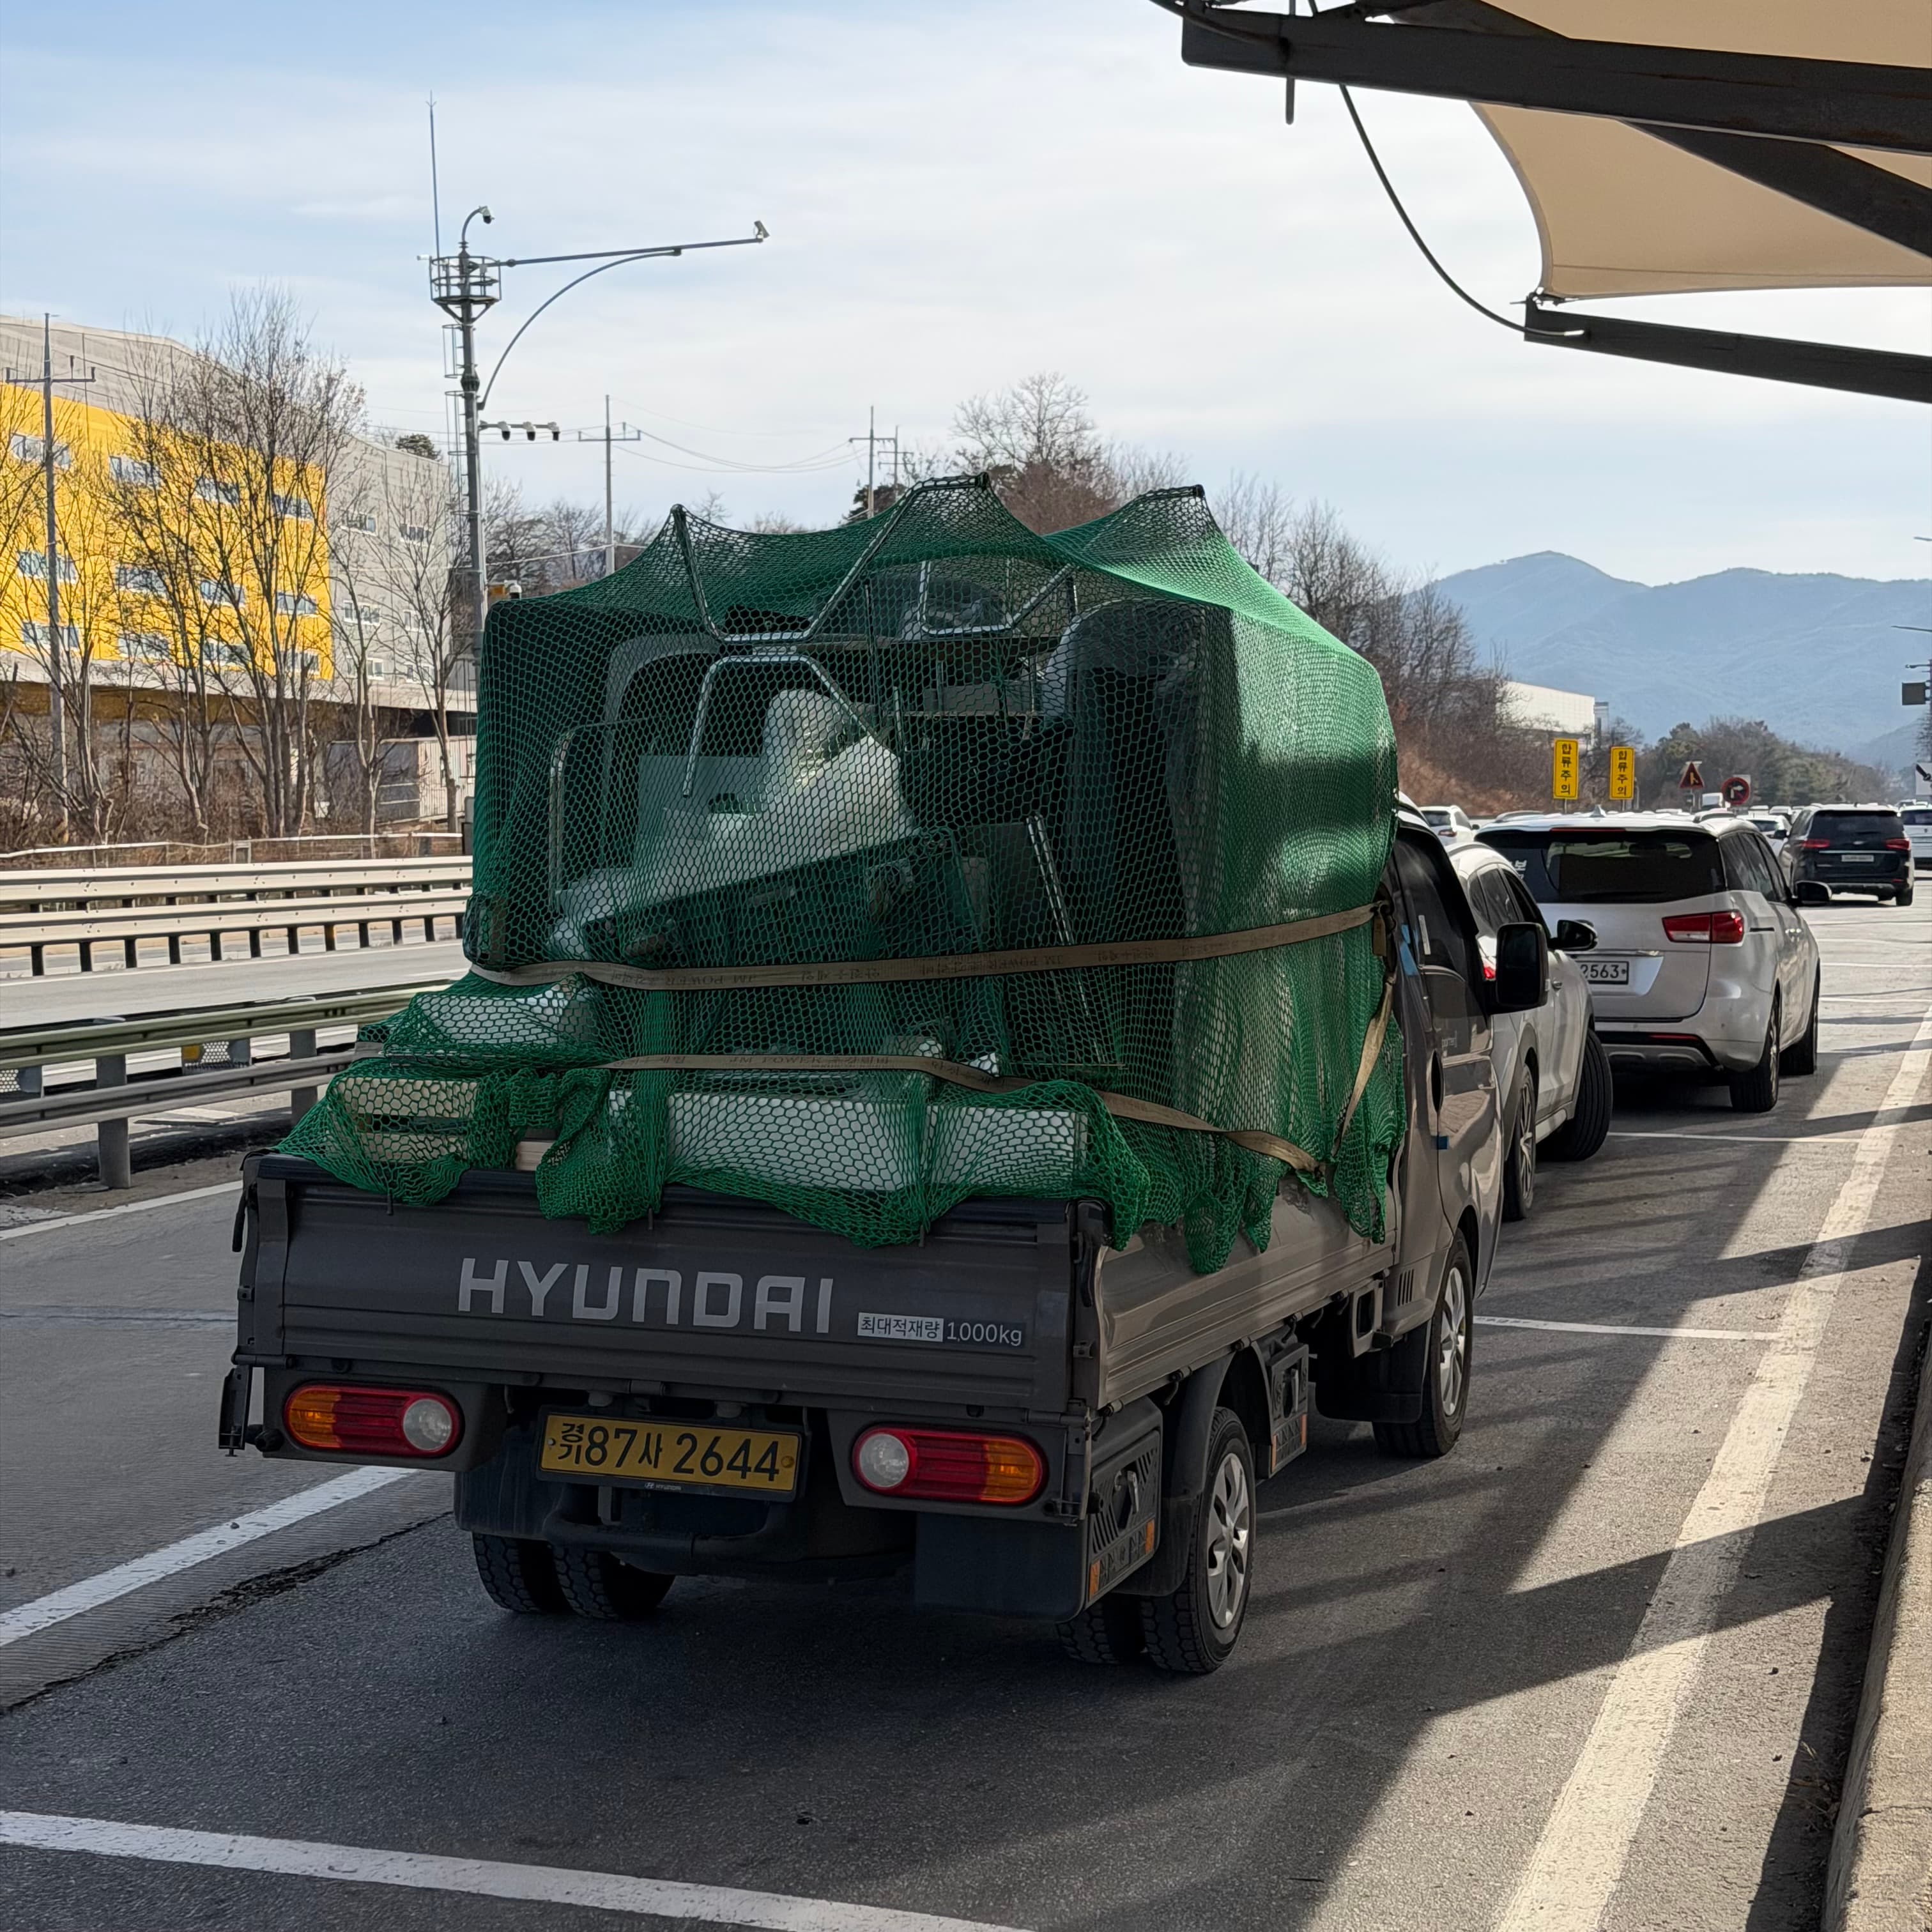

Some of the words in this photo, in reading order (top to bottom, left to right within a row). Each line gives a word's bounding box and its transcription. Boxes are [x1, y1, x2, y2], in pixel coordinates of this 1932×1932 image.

[1560, 743, 1572, 795] 합류주의
[1616, 750, 1628, 796] 합류주의
[665, 975, 724, 986] POWER
[1580, 964, 1619, 979] 2563
[458, 1257, 834, 1333] HYUNDAI
[861, 1316, 940, 1339] 최대적재량
[673, 1432, 779, 1482] 2644
